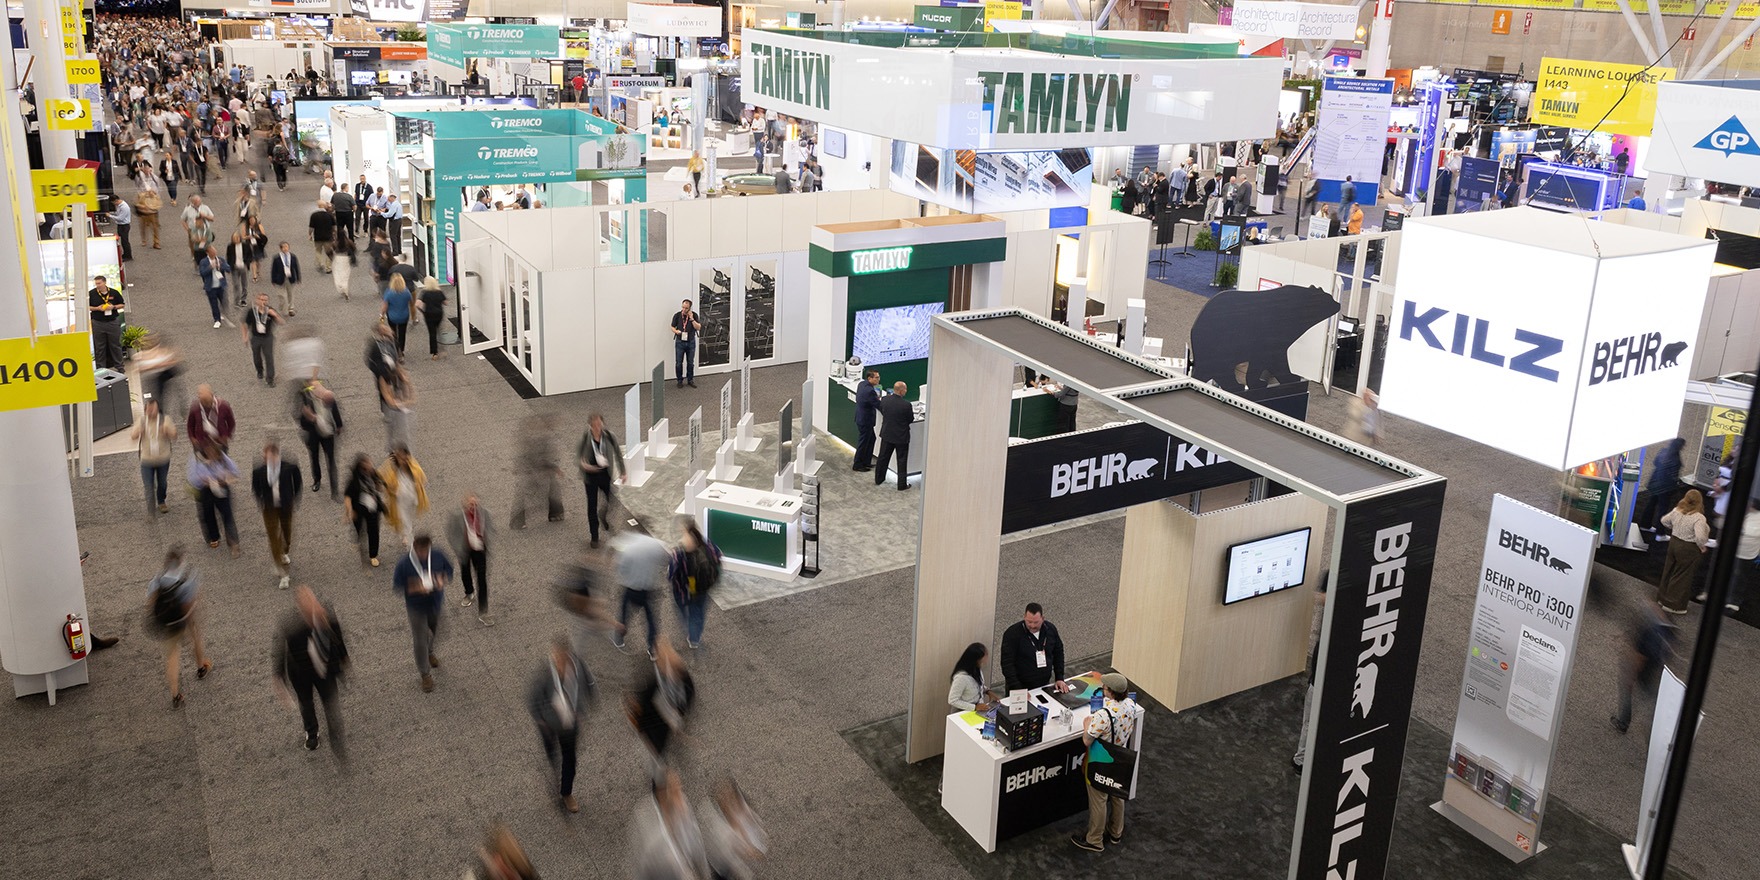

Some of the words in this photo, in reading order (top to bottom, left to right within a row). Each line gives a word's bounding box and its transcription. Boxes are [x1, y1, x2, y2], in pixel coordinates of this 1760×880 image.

[922, 13, 953, 23] NUCOR
[1233, 7, 1298, 22] Architectural
[1300, 11, 1356, 24] Architectural
[481, 29, 524, 38] TREMCO
[1232, 19, 1267, 32] Record
[1298, 24, 1332, 36] Record
[71, 67, 95, 75] 1700
[750, 42, 830, 111] TAMLYN
[1546, 65, 1605, 79] LEARNING
[1607, 71, 1657, 84] LOUNGE
[1544, 79, 1569, 90] 1443
[977, 71, 1132, 135] TAMLYN
[1541, 99, 1580, 114] TAMLYN
[503, 118, 542, 127] TREMCO
[1710, 130, 1750, 151] GP
[493, 147, 538, 158] TREMCO
[40, 184, 87, 197] 1500
[853, 249, 910, 272] TAMLYN
[1400, 300, 1564, 383] KILZ
[1589, 331, 1662, 386] BEHR
[1050, 452, 1127, 498] BEHR
[1175, 443, 1230, 472] KI
[751, 519, 781, 535] TAMLYN
[1498, 528, 1550, 566] BEHR
[1357, 522, 1413, 666] BEHR
[1485, 567, 1515, 592] BEHR
[1546, 595, 1575, 619] i300
[1482, 583, 1535, 615] INTERIOR
[1536, 608, 1573, 631] PAINT
[1522, 630, 1558, 653] Declare.
[1005, 765, 1046, 793] BEHR
[1094, 772, 1114, 787] BEHR
